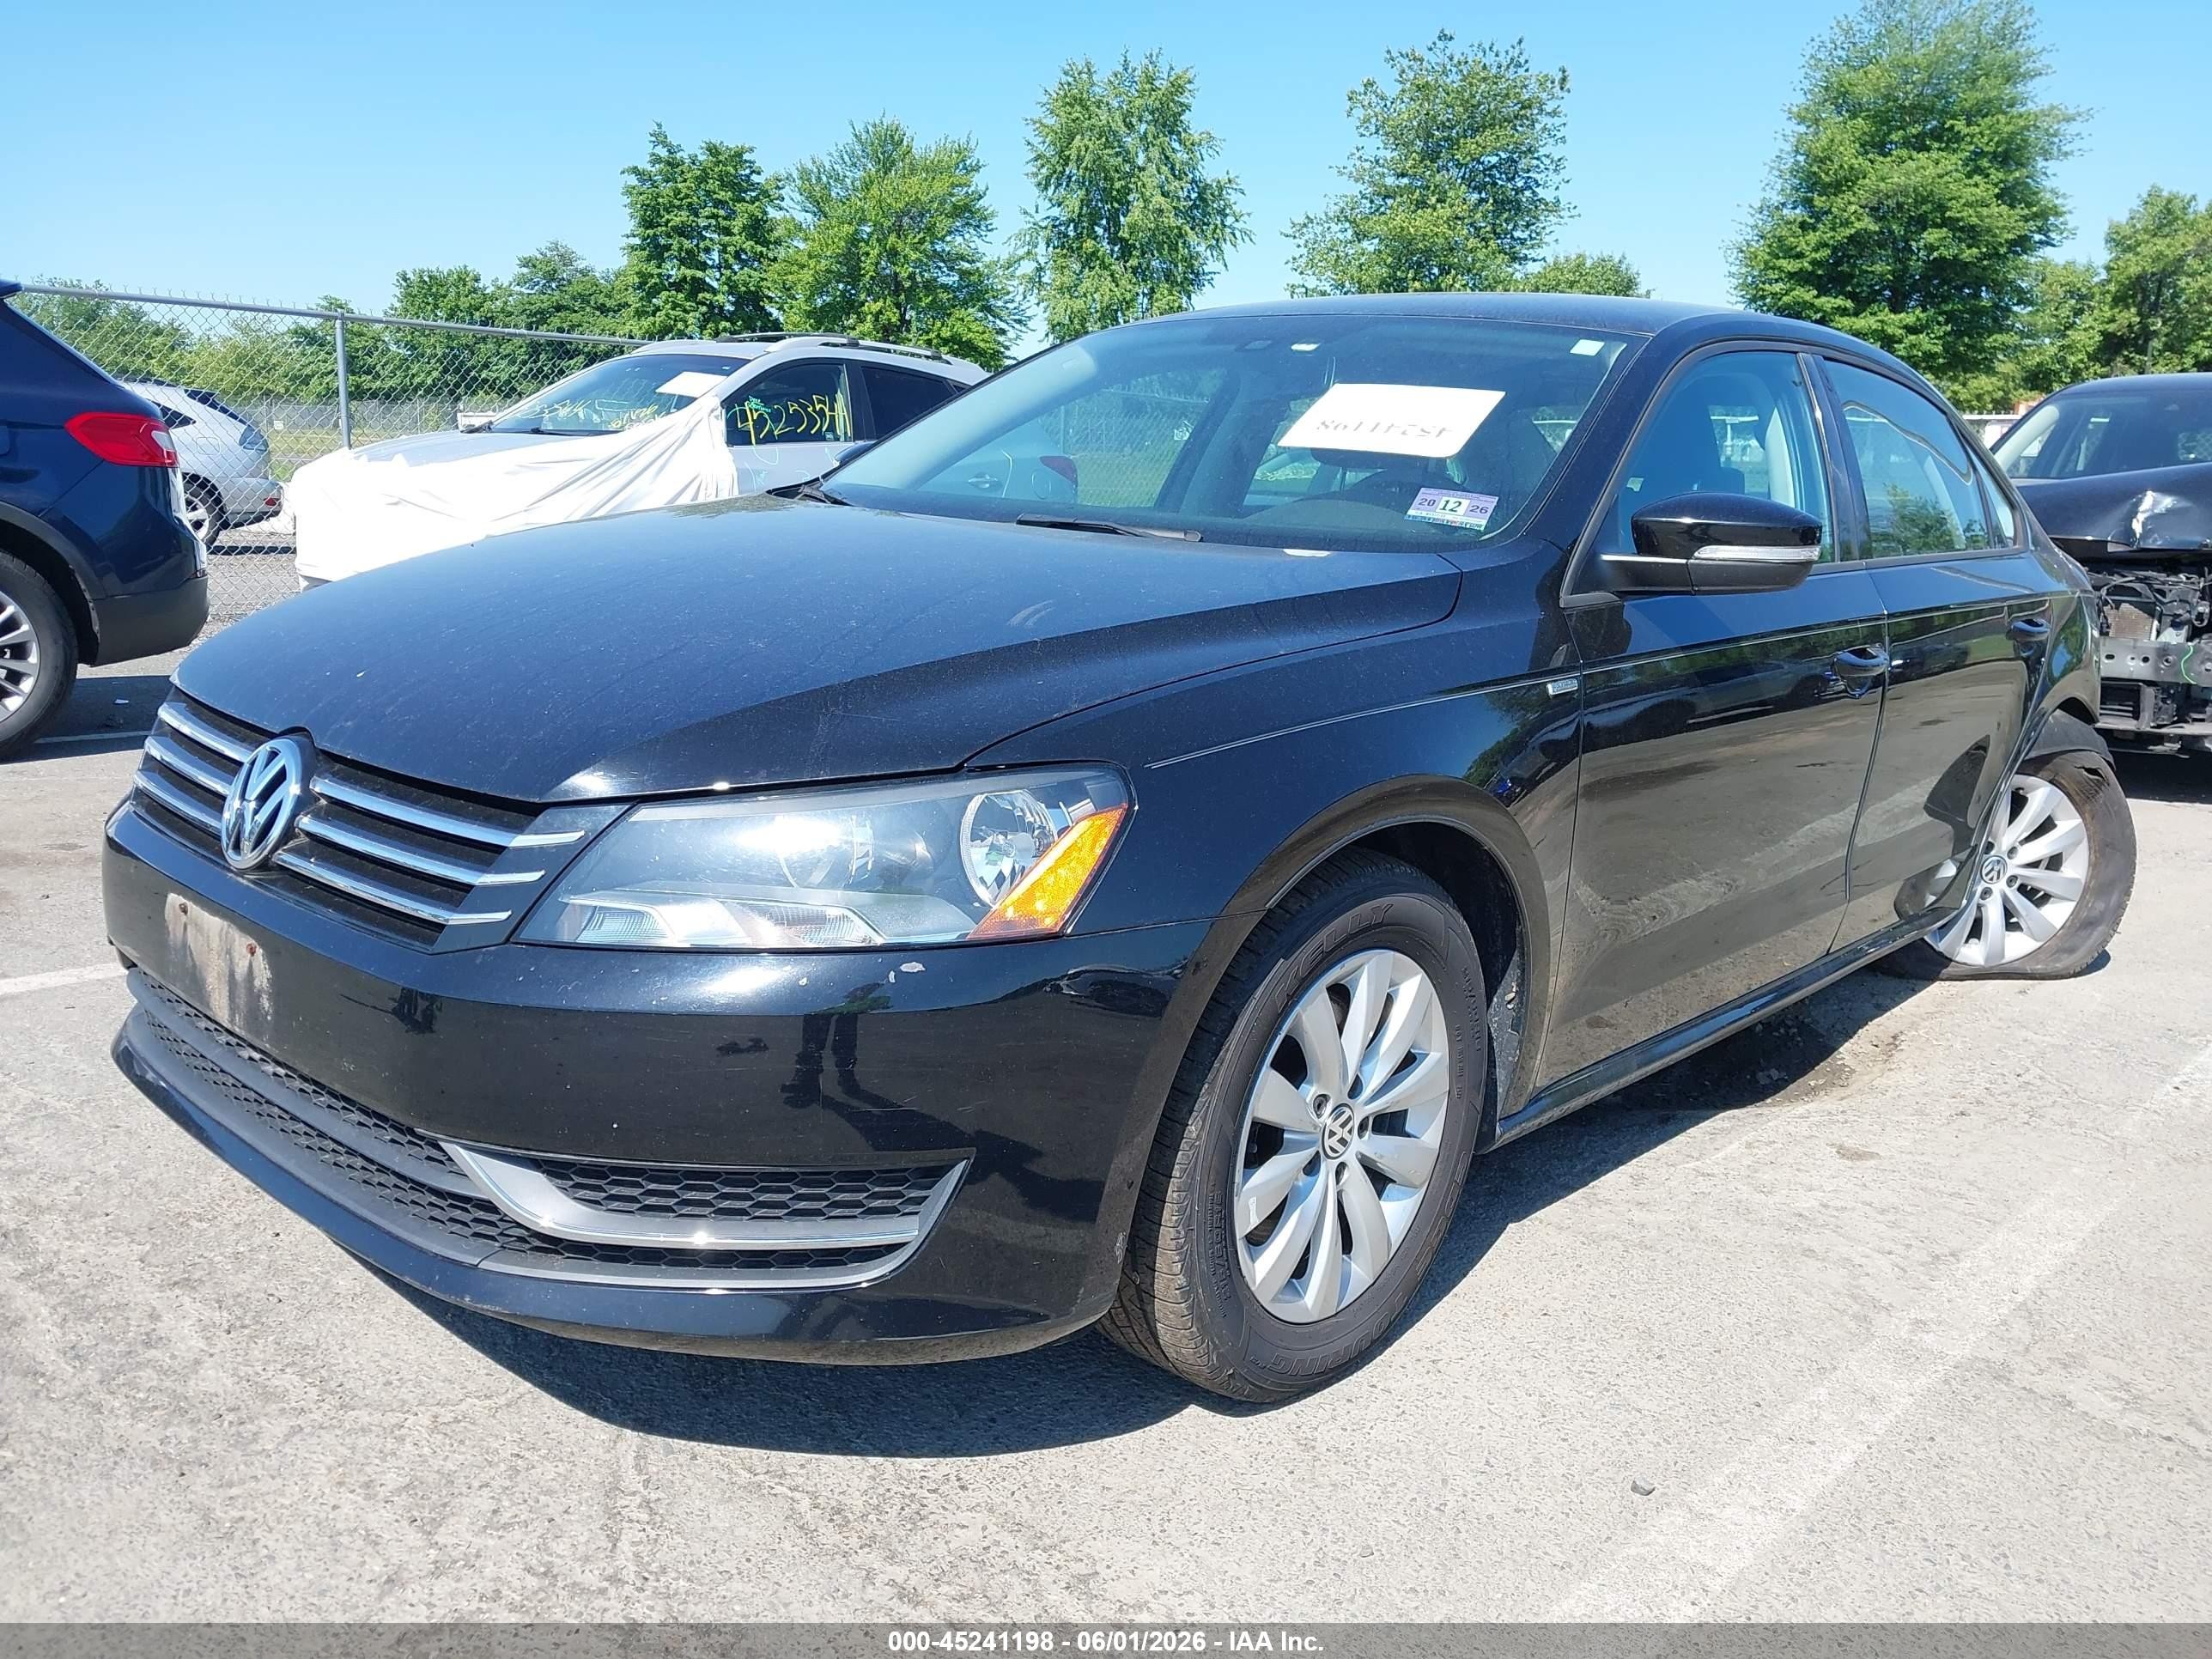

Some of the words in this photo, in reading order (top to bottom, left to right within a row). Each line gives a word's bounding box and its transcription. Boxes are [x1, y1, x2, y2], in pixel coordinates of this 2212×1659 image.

[1418, 498, 1436, 507] 20
[1439, 500, 1462, 513] 12
[1469, 505, 1489, 514] 26
[1274, 902, 1395, 1014] KELLY
